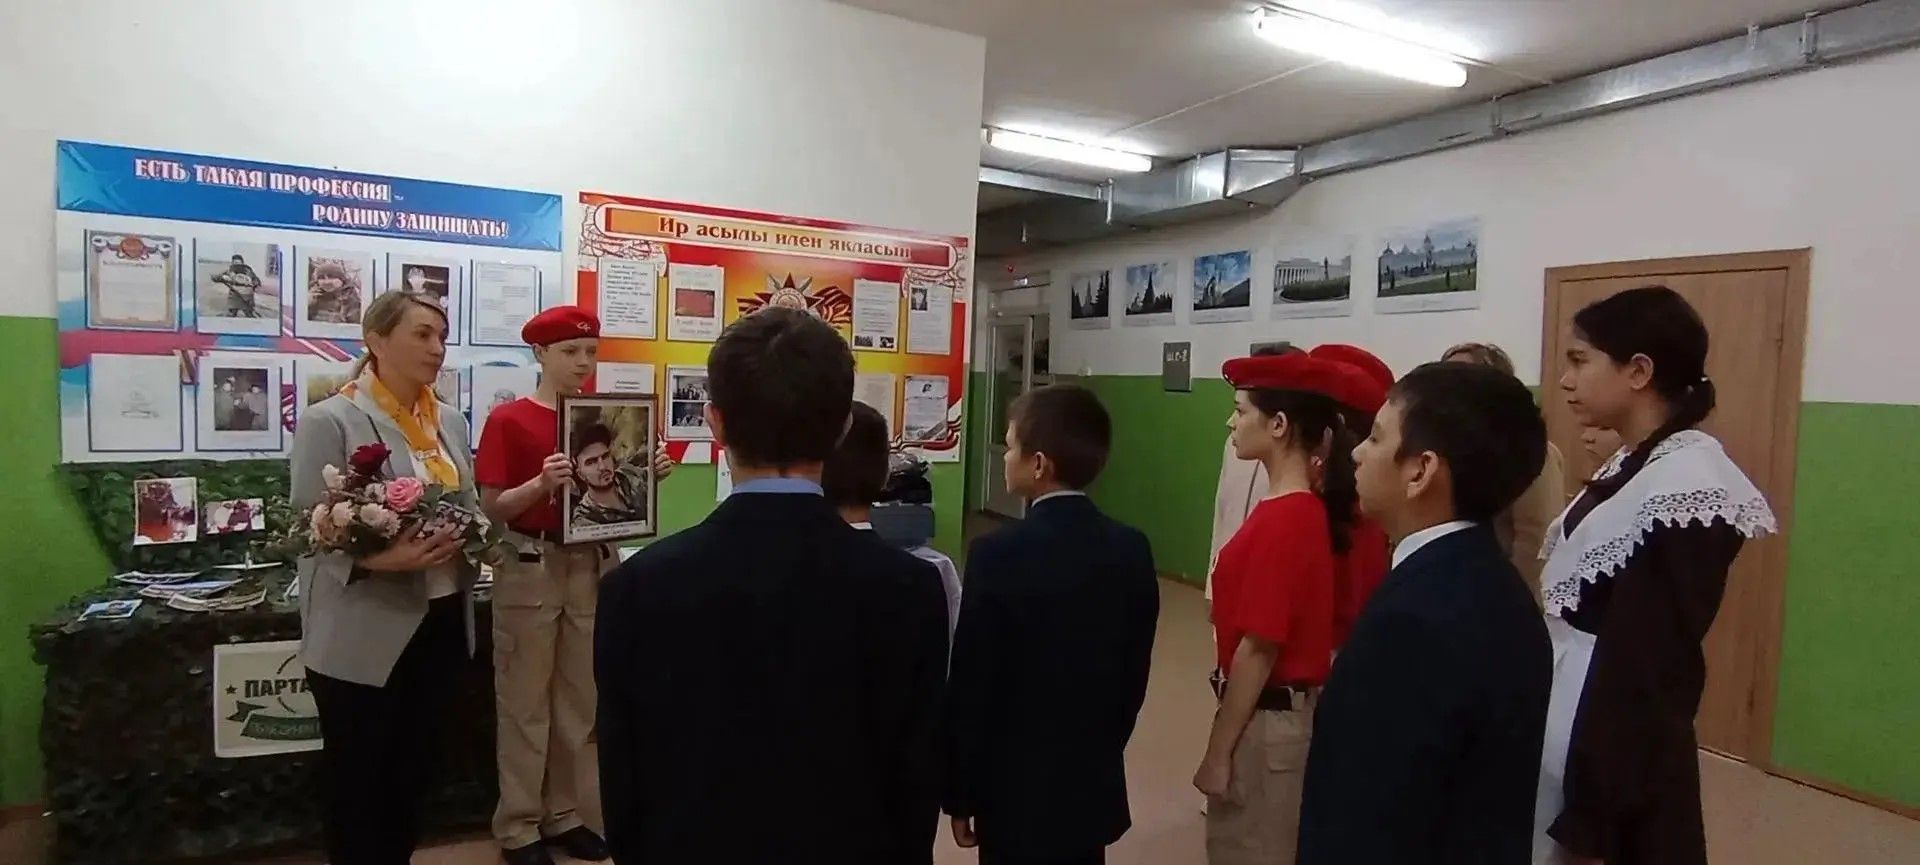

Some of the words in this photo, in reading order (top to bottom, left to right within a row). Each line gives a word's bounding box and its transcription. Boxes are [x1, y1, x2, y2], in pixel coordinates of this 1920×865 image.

[135, 158, 188, 182] ЕСТЬ
[193, 164, 265, 189] ТАКАЯ
[270, 172, 391, 202] ПРОФЕССИЯ
[312, 203, 391, 227] РОДИНУ
[395, 212, 508, 240] ЗАЩИЩАТЬ!
[659, 216, 689, 237] Ир
[696, 224, 768, 242] асылы
[775, 232, 822, 249] илен
